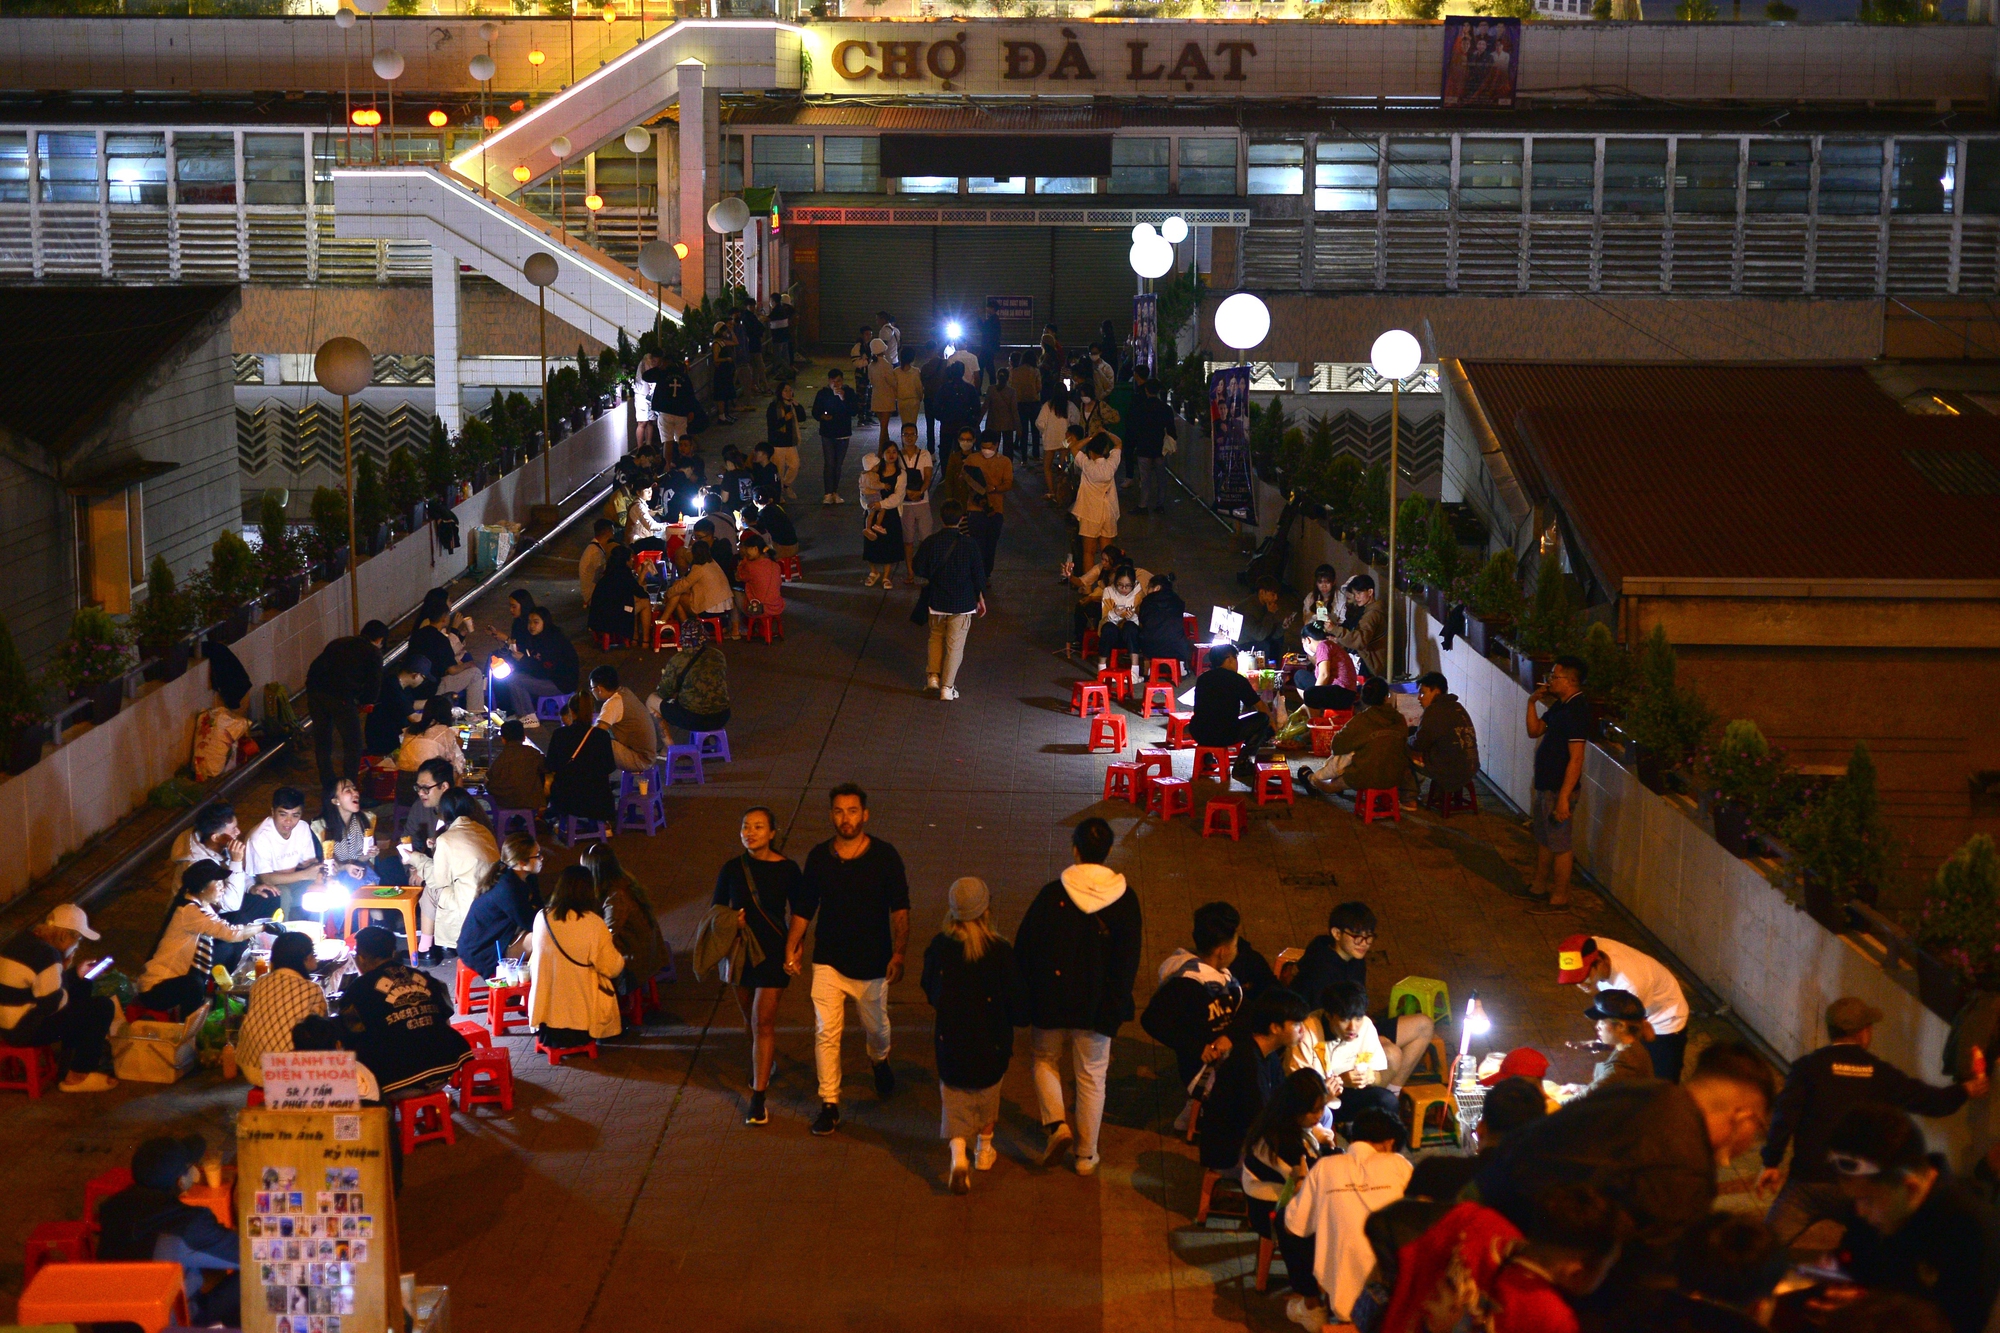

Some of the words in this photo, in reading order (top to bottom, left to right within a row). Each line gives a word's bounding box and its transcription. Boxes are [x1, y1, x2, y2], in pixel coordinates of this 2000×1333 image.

[831, 32, 966, 91] CHỢ
[1003, 27, 1096, 81] ĐÀ
[1126, 41, 1257, 92] LẠT
[271, 1057, 286, 1066] IN
[291, 1055, 322, 1066] ẢNH
[265, 1068, 302, 1082] ĐIỆN
[305, 1069, 356, 1082] THOẠI
[272, 1100, 279, 1109] 2
[282, 1098, 308, 1109] PHÚT
[328, 1100, 355, 1109] NGAY
